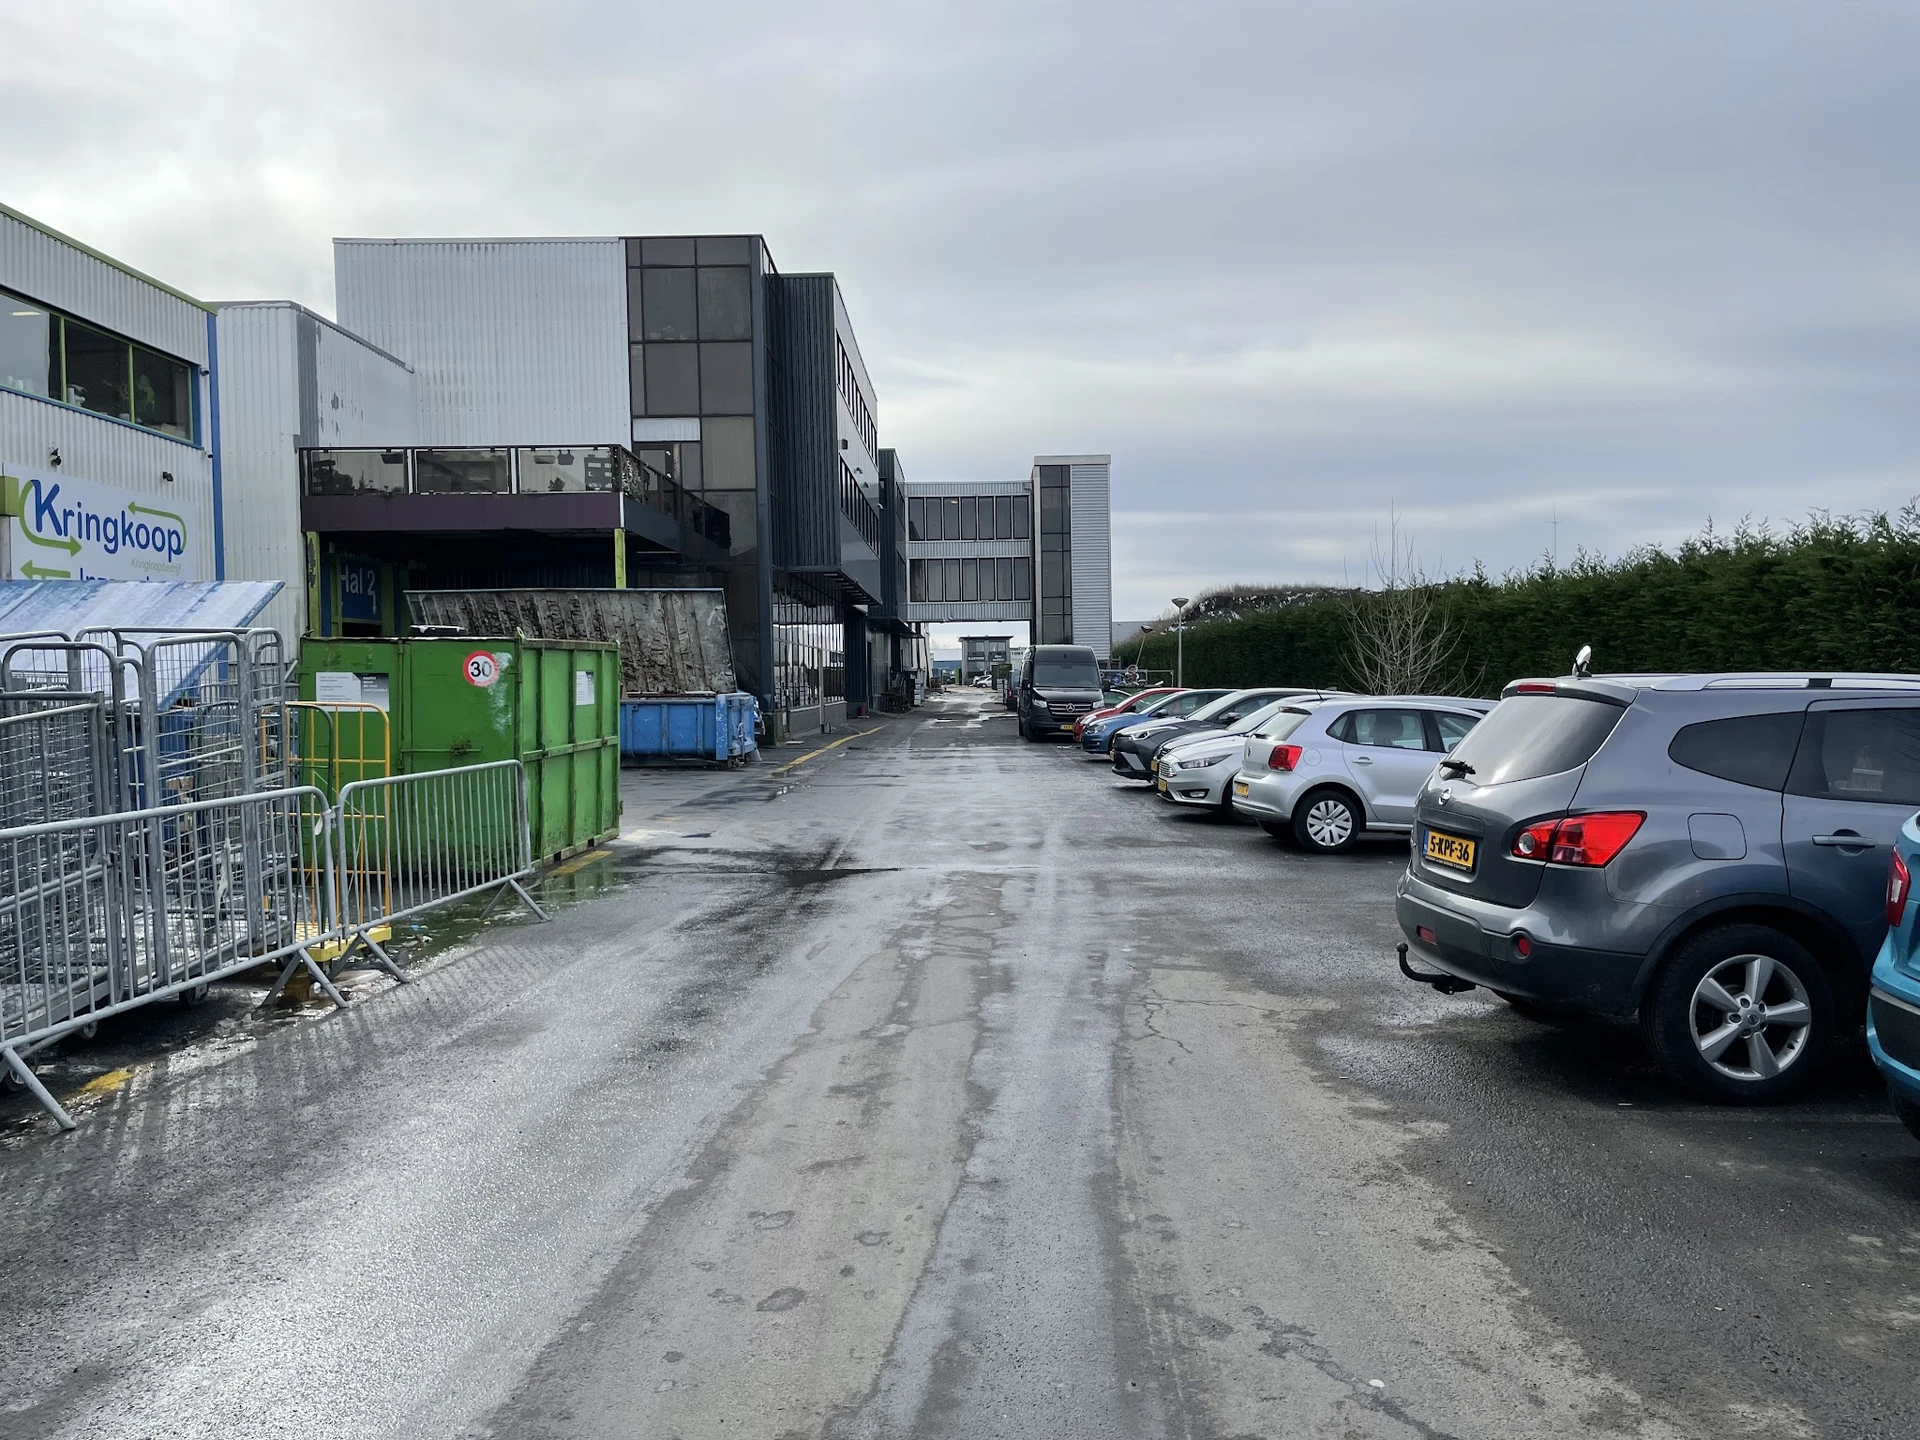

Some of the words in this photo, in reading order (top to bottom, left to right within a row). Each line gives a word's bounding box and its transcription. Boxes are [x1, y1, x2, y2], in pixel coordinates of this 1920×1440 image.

[30, 479, 184, 563] Kringkoop
[341, 564, 363, 595] Hal
[367, 569, 376, 596] 2
[470, 661, 492, 678] 30
[1430, 835, 1470, 862] 5-KPF-36
